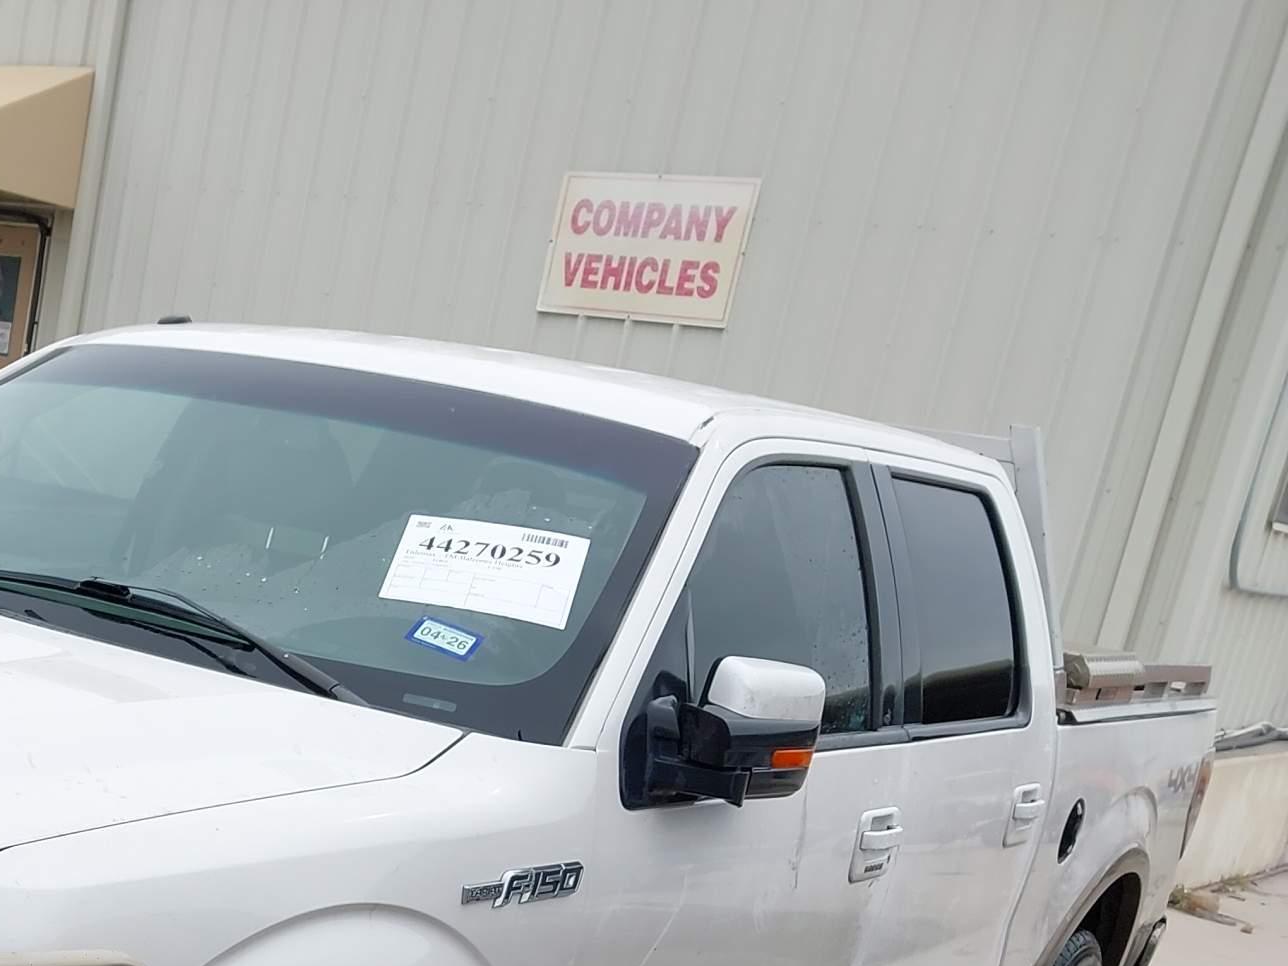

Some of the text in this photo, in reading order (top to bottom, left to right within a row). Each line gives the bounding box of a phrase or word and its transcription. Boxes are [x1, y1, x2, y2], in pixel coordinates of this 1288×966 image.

[571, 198, 737, 243] COMPANY
[564, 252, 720, 299] VEHICLES
[418, 536, 561, 568] 44270259
